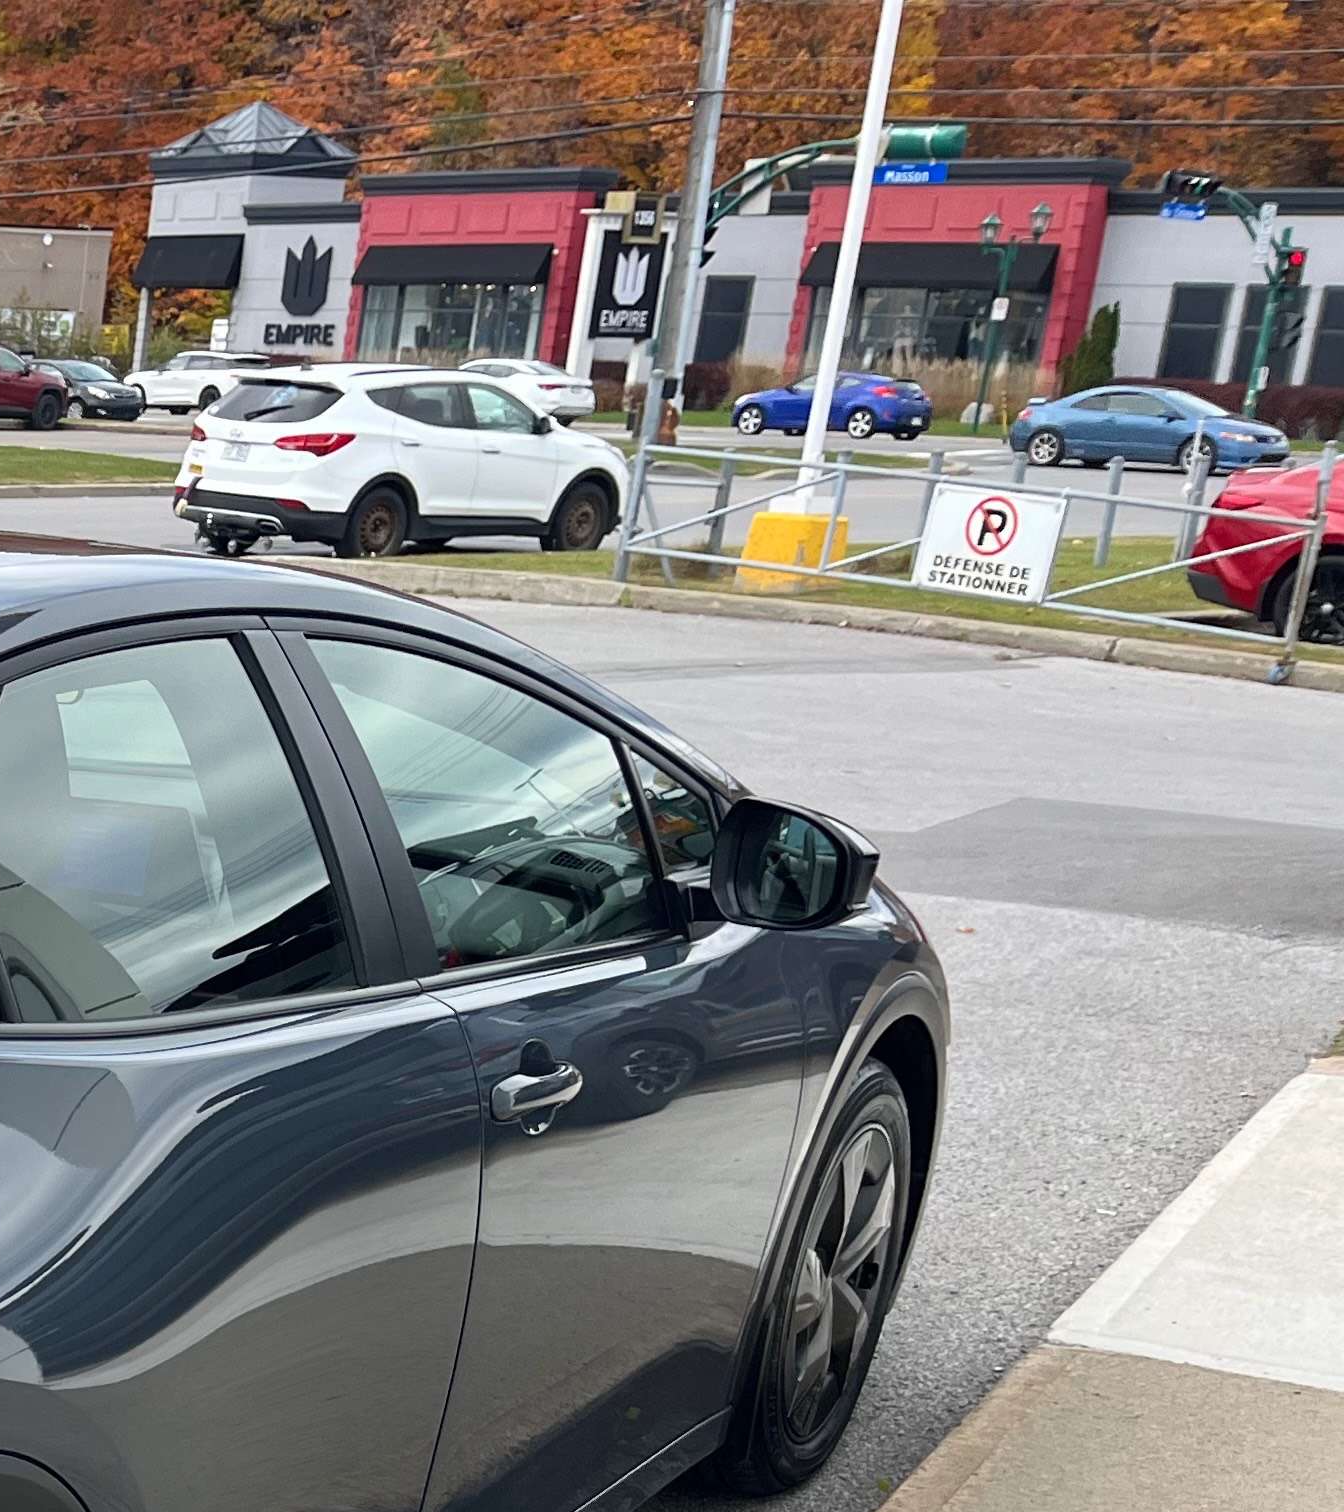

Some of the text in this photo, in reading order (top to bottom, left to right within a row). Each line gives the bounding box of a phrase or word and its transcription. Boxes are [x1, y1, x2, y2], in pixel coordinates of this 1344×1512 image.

[599, 309, 649, 328] EMPIRE
[263, 323, 335, 346] EMPIRE
[928, 570, 1028, 596] STATIONNER
[1009, 566, 1031, 581] DE
